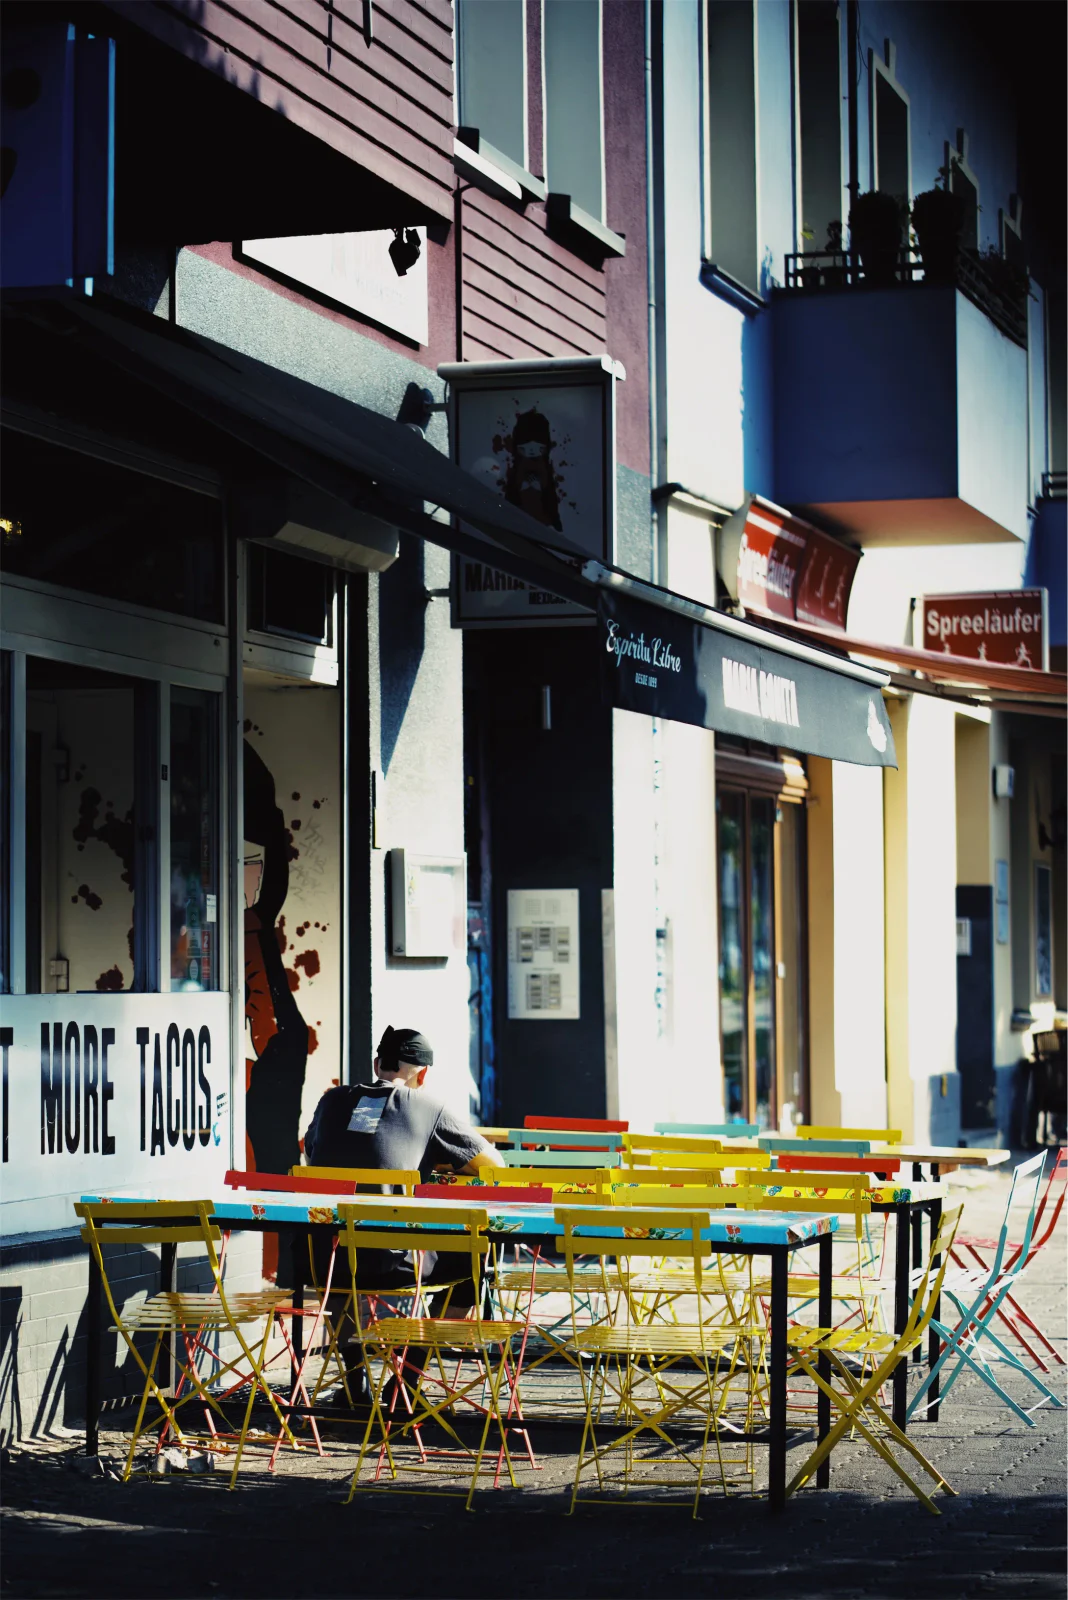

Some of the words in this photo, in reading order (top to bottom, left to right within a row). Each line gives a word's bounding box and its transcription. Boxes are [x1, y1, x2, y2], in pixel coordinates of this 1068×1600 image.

[926, 607, 1041, 642] Spreeläufer
[651, 635, 681, 672] Libre
[635, 672, 648, 685] DESDE
[41, 1022, 115, 1155] MORE
[136, 1023, 211, 1156] TACOS
